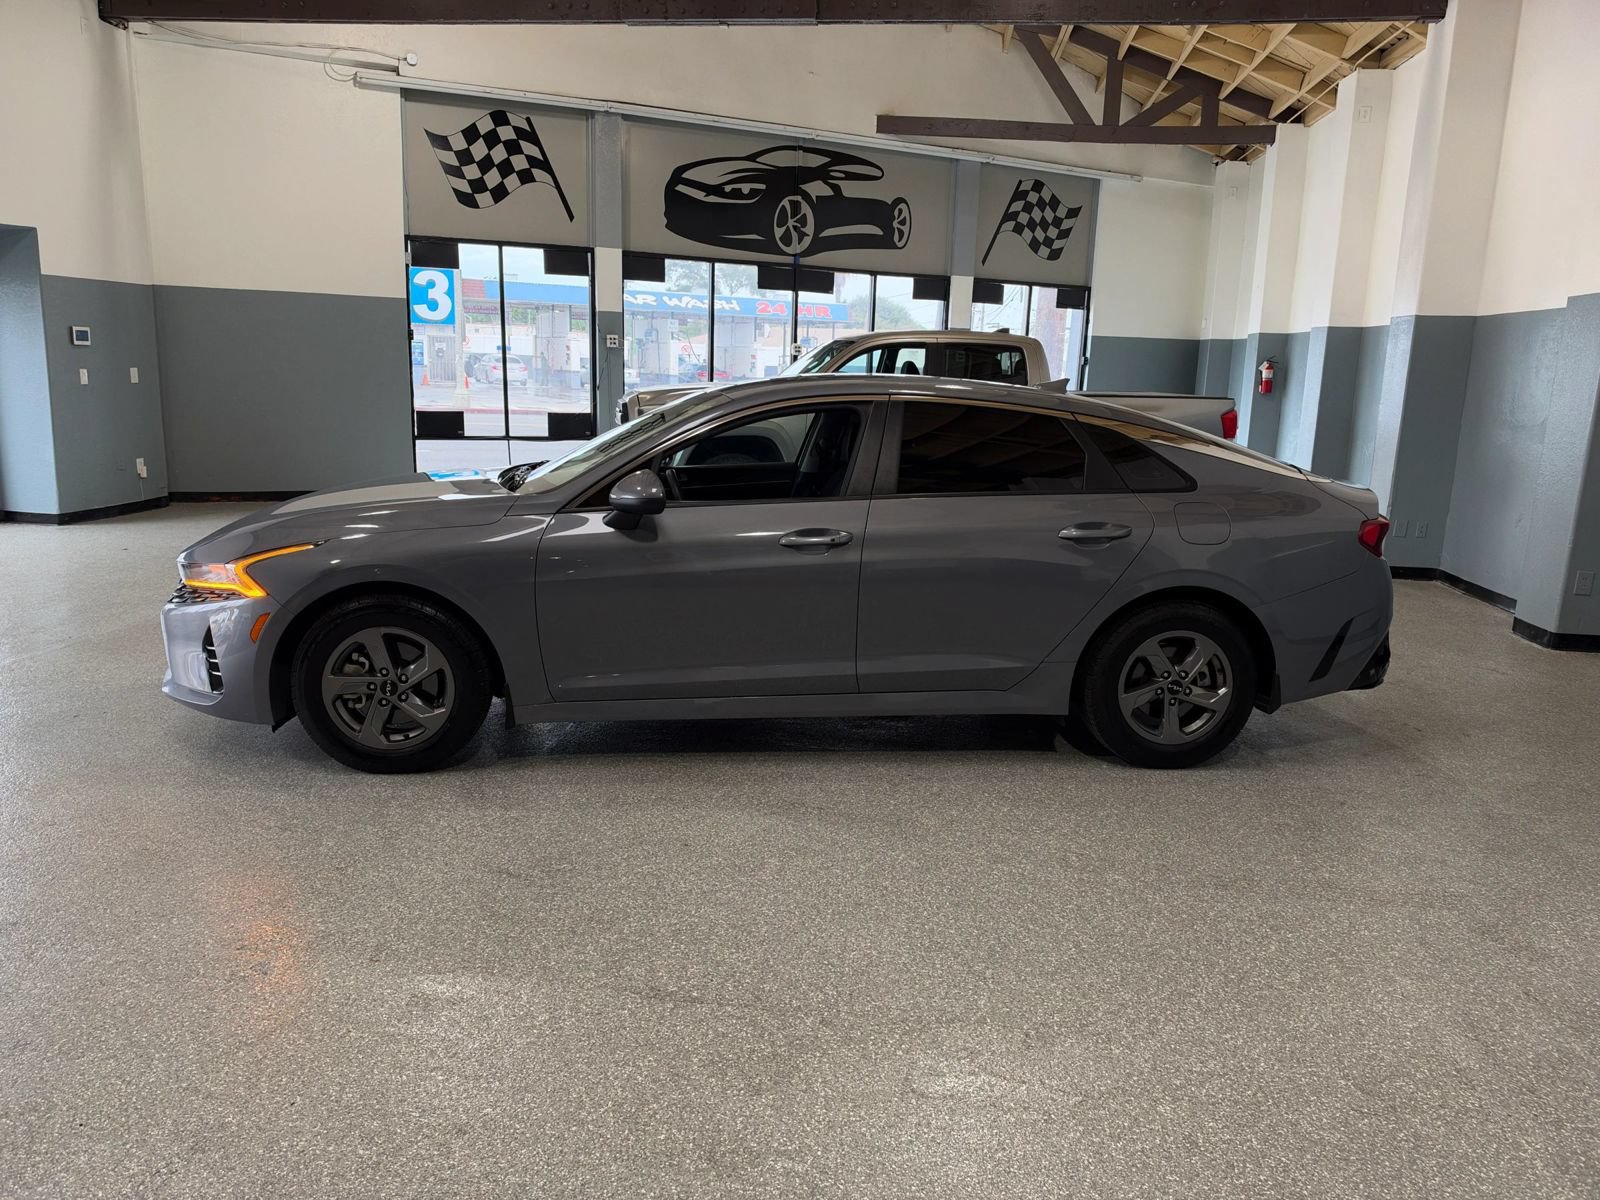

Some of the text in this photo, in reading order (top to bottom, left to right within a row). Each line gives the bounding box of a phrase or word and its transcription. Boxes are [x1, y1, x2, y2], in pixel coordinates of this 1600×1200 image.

[413, 270, 452, 321] 3
[624, 293, 832, 318] AR WASH 24 HR
